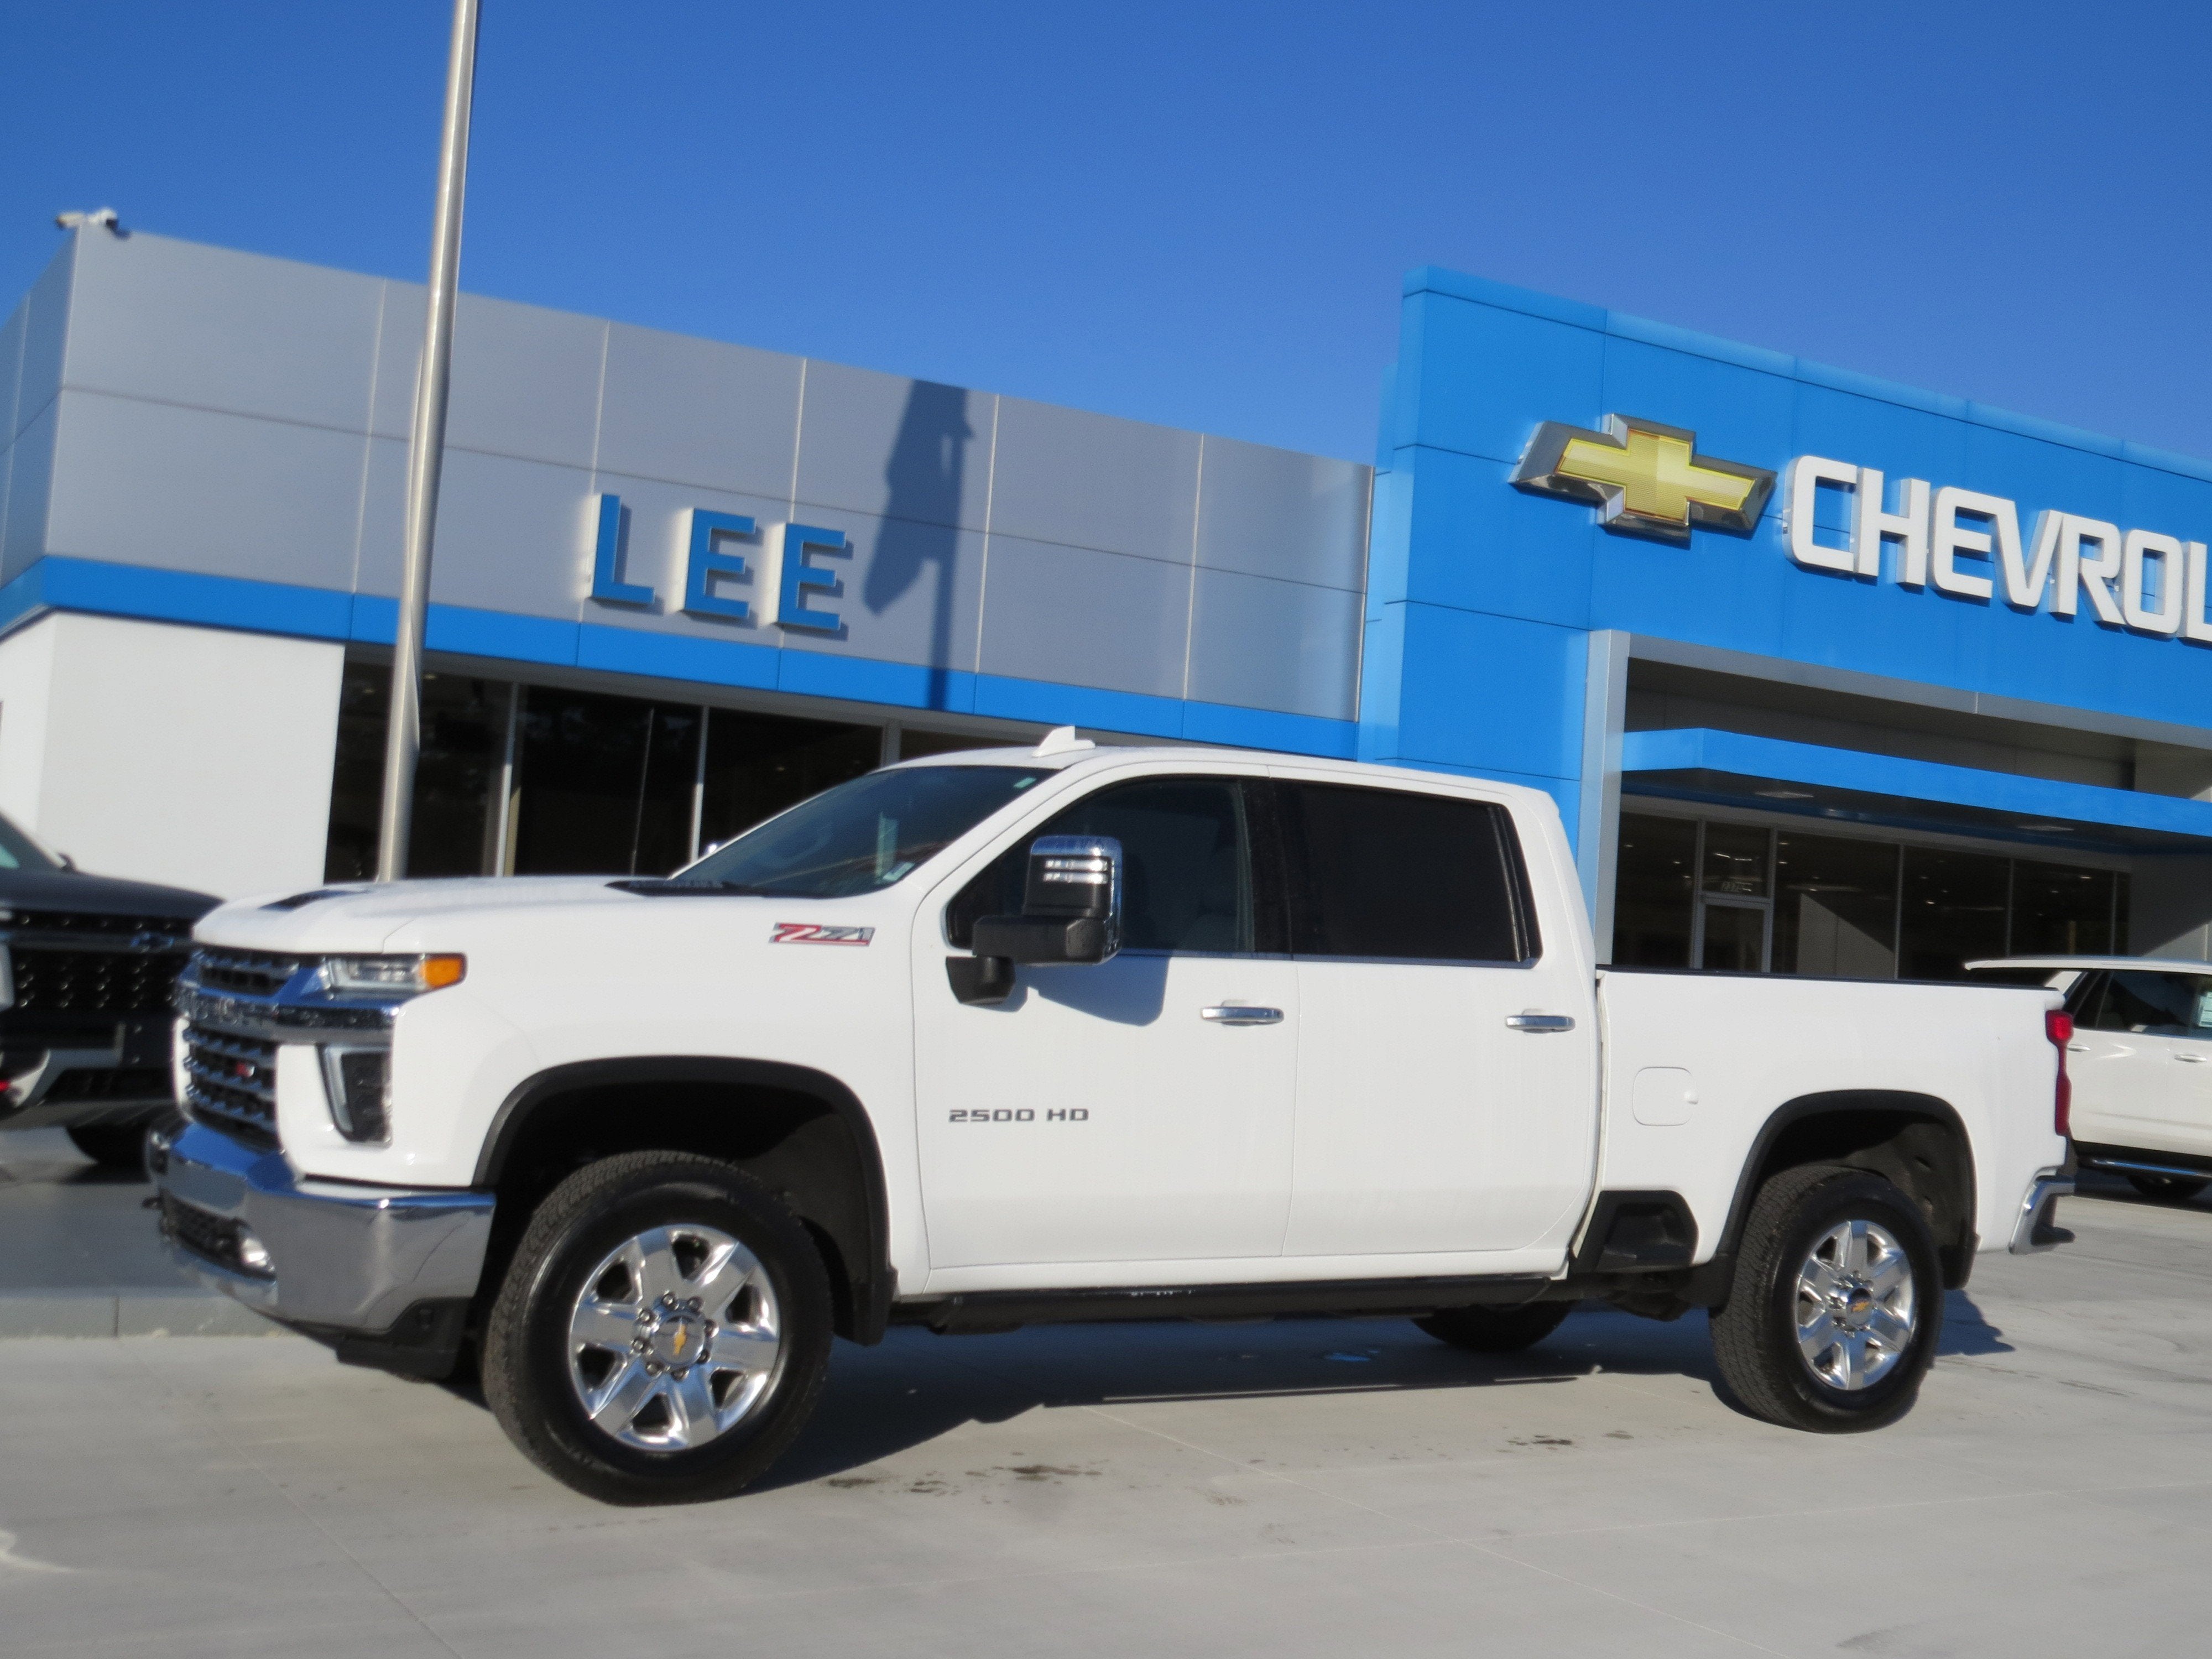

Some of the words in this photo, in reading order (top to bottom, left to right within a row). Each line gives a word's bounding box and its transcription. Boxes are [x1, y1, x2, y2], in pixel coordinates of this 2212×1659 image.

[588, 493, 847, 630] LEE
[1784, 455, 2212, 643] CHEVROL
[769, 922, 875, 947] Z71
[948, 1109, 1035, 1122] 2500
[1046, 1108, 1089, 1121] HD
